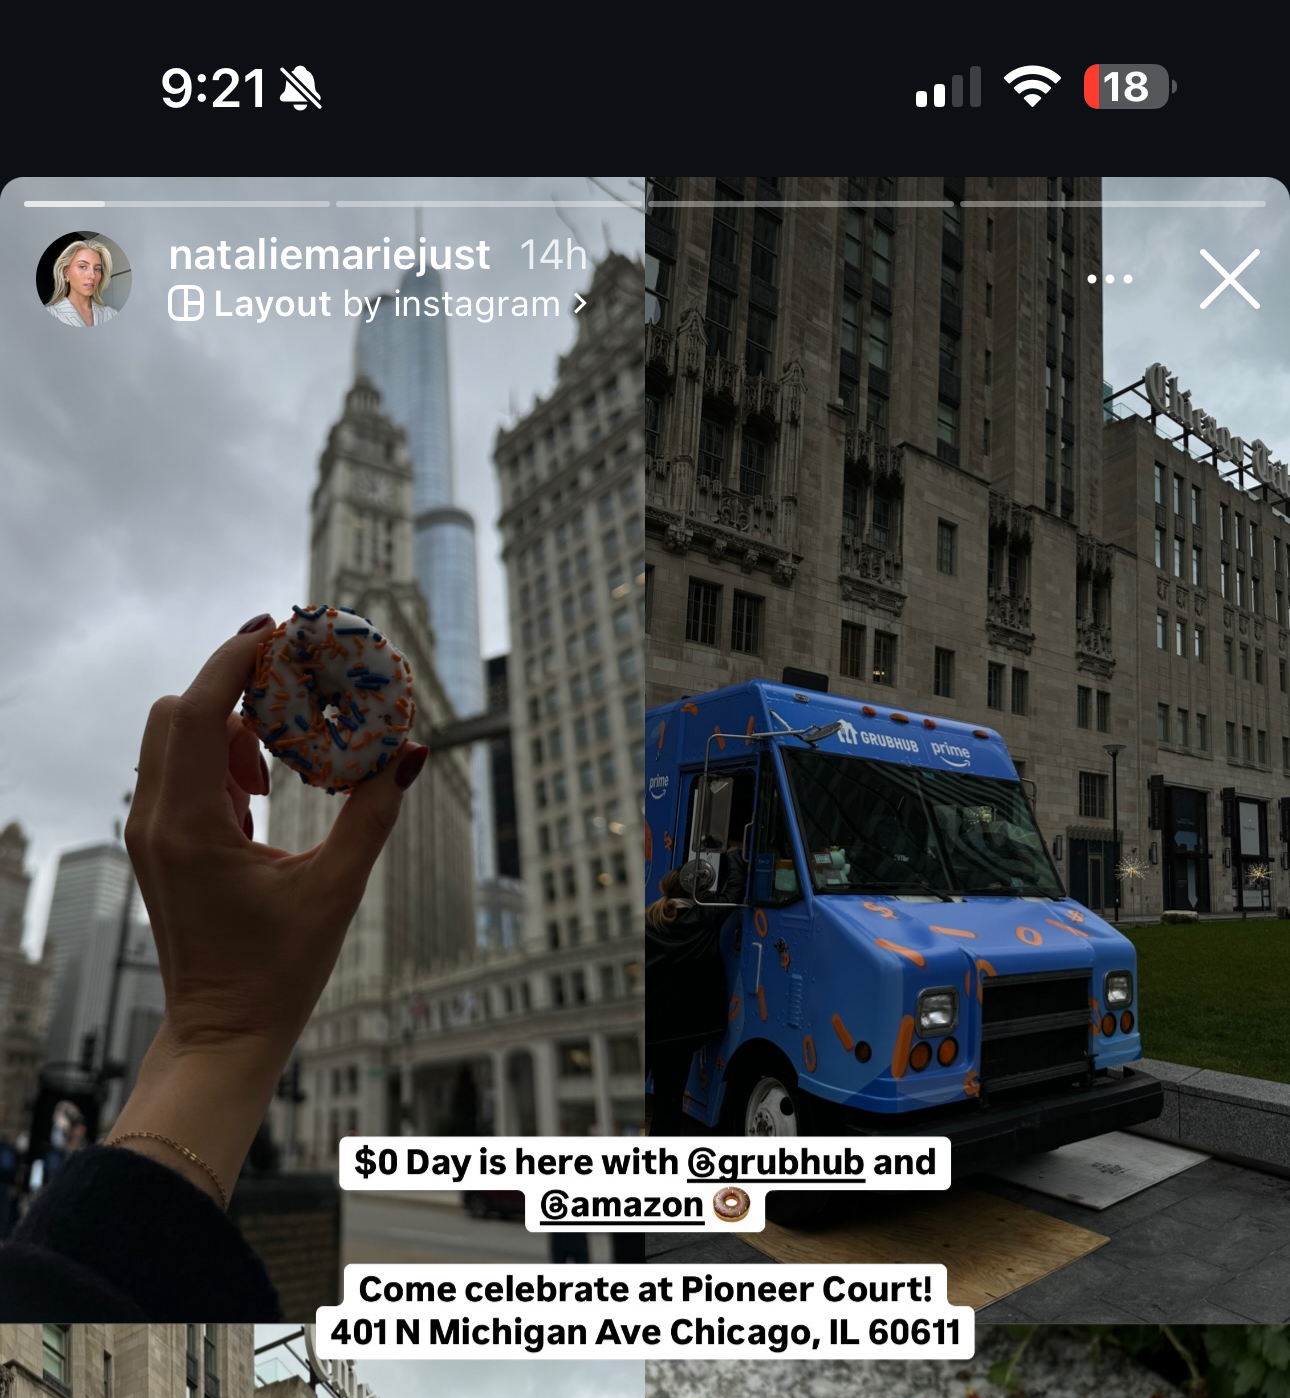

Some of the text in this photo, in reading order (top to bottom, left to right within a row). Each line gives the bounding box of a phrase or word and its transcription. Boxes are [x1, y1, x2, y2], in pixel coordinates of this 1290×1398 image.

[860, 731, 971, 759] GRUBHUB prime
[649, 774, 669, 791] prime
